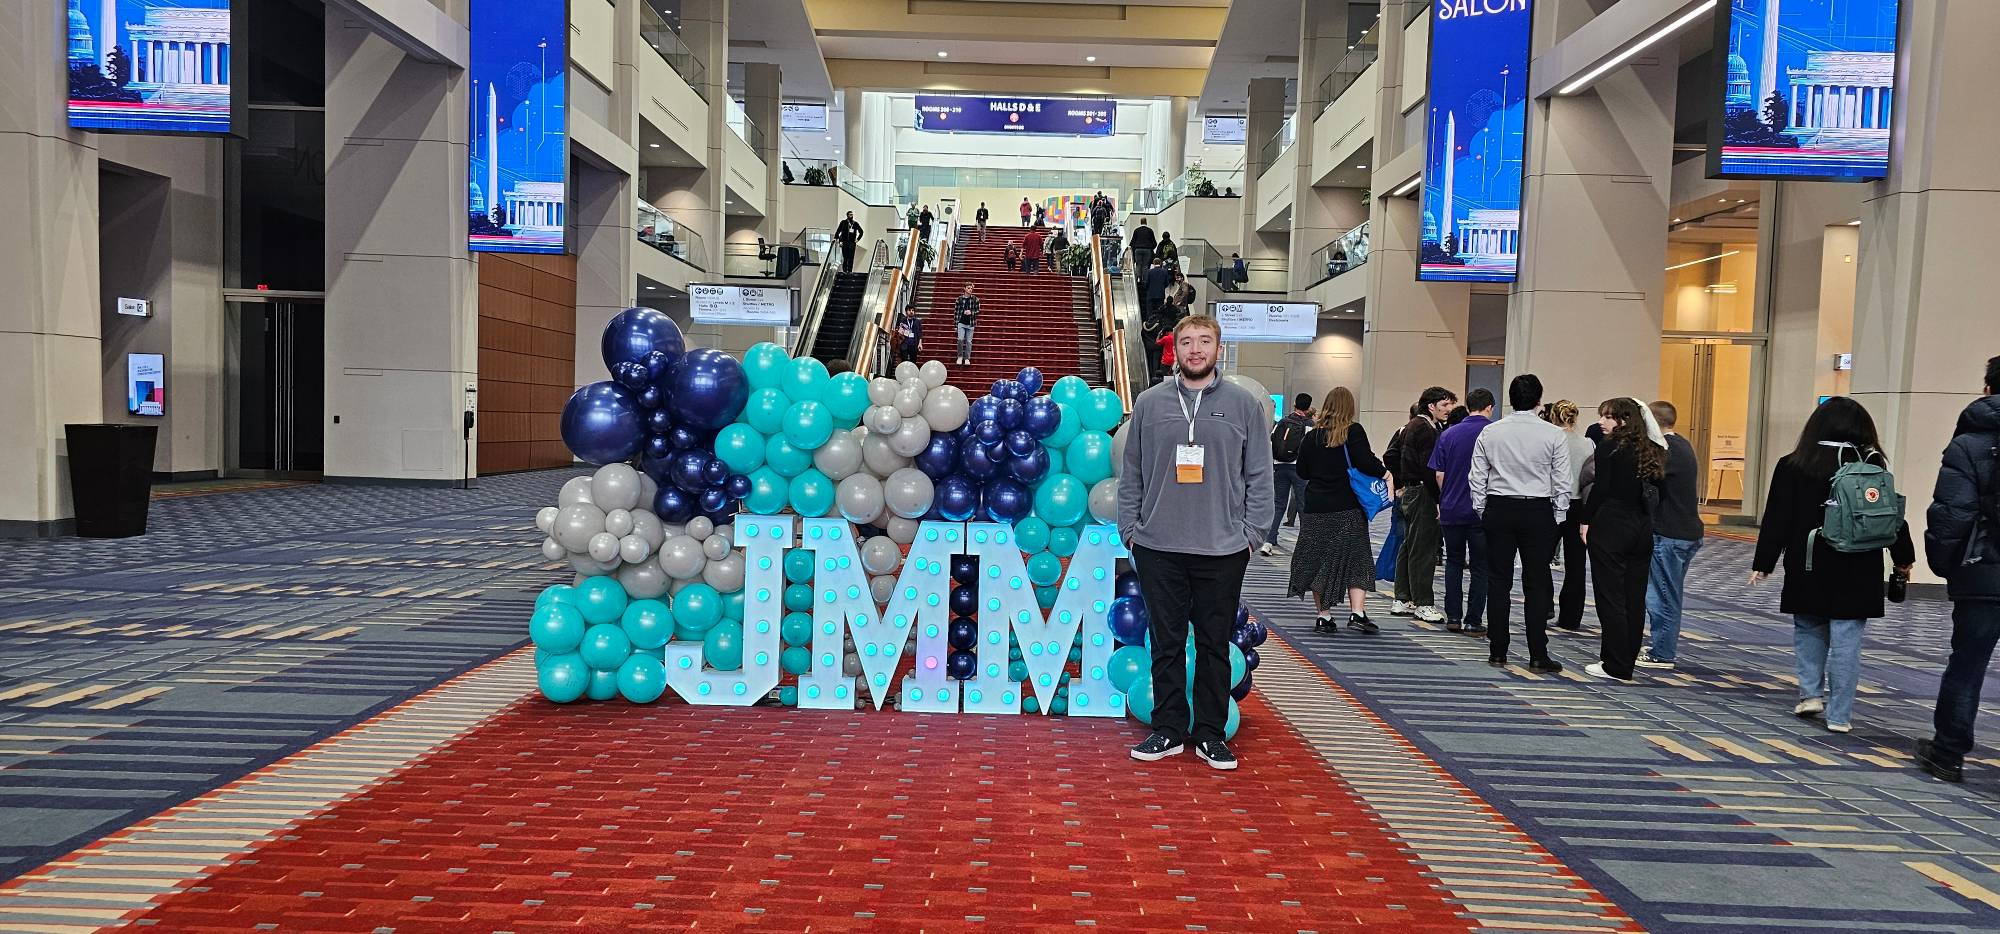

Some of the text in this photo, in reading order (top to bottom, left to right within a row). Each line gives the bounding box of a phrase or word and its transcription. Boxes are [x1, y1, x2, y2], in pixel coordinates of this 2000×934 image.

[990, 102, 1041, 112] HALLS D & E
[665, 513, 1129, 719] JMM
